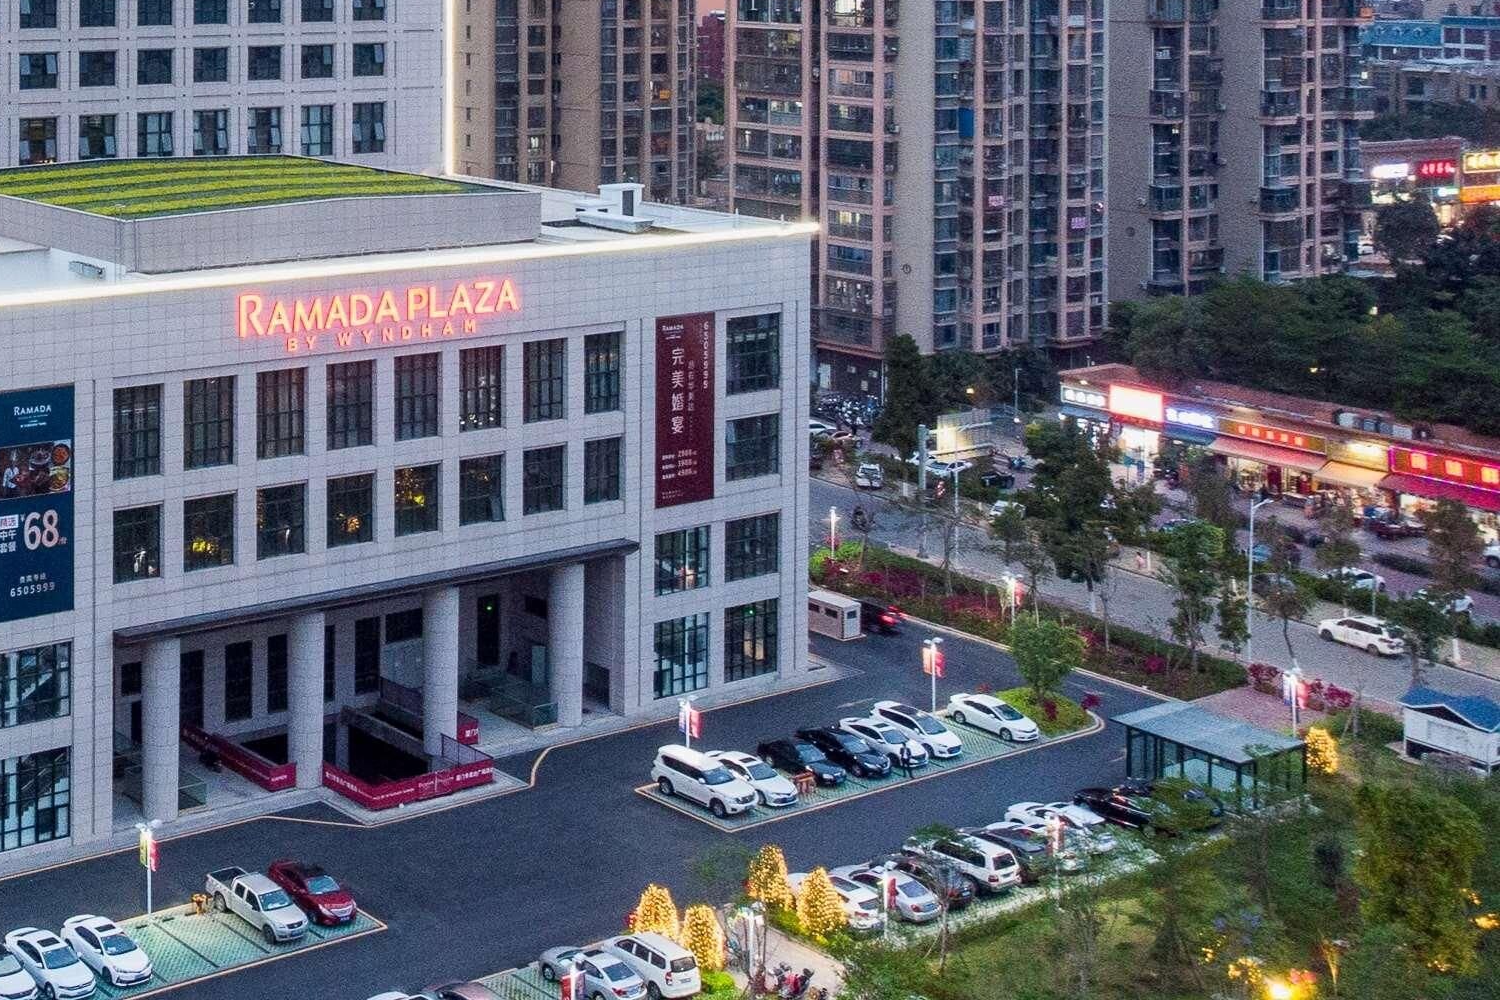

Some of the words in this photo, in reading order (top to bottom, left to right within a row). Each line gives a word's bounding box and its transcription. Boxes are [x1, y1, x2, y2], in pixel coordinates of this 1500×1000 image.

[238, 291, 400, 338] RAMADA
[407, 278, 519, 322] PLAZA
[286, 334, 319, 353] BY
[338, 319, 478, 347] WYNDHAM
[13, 404, 52, 416] RAMADA
[671, 348, 684, 434] 完美婚宴
